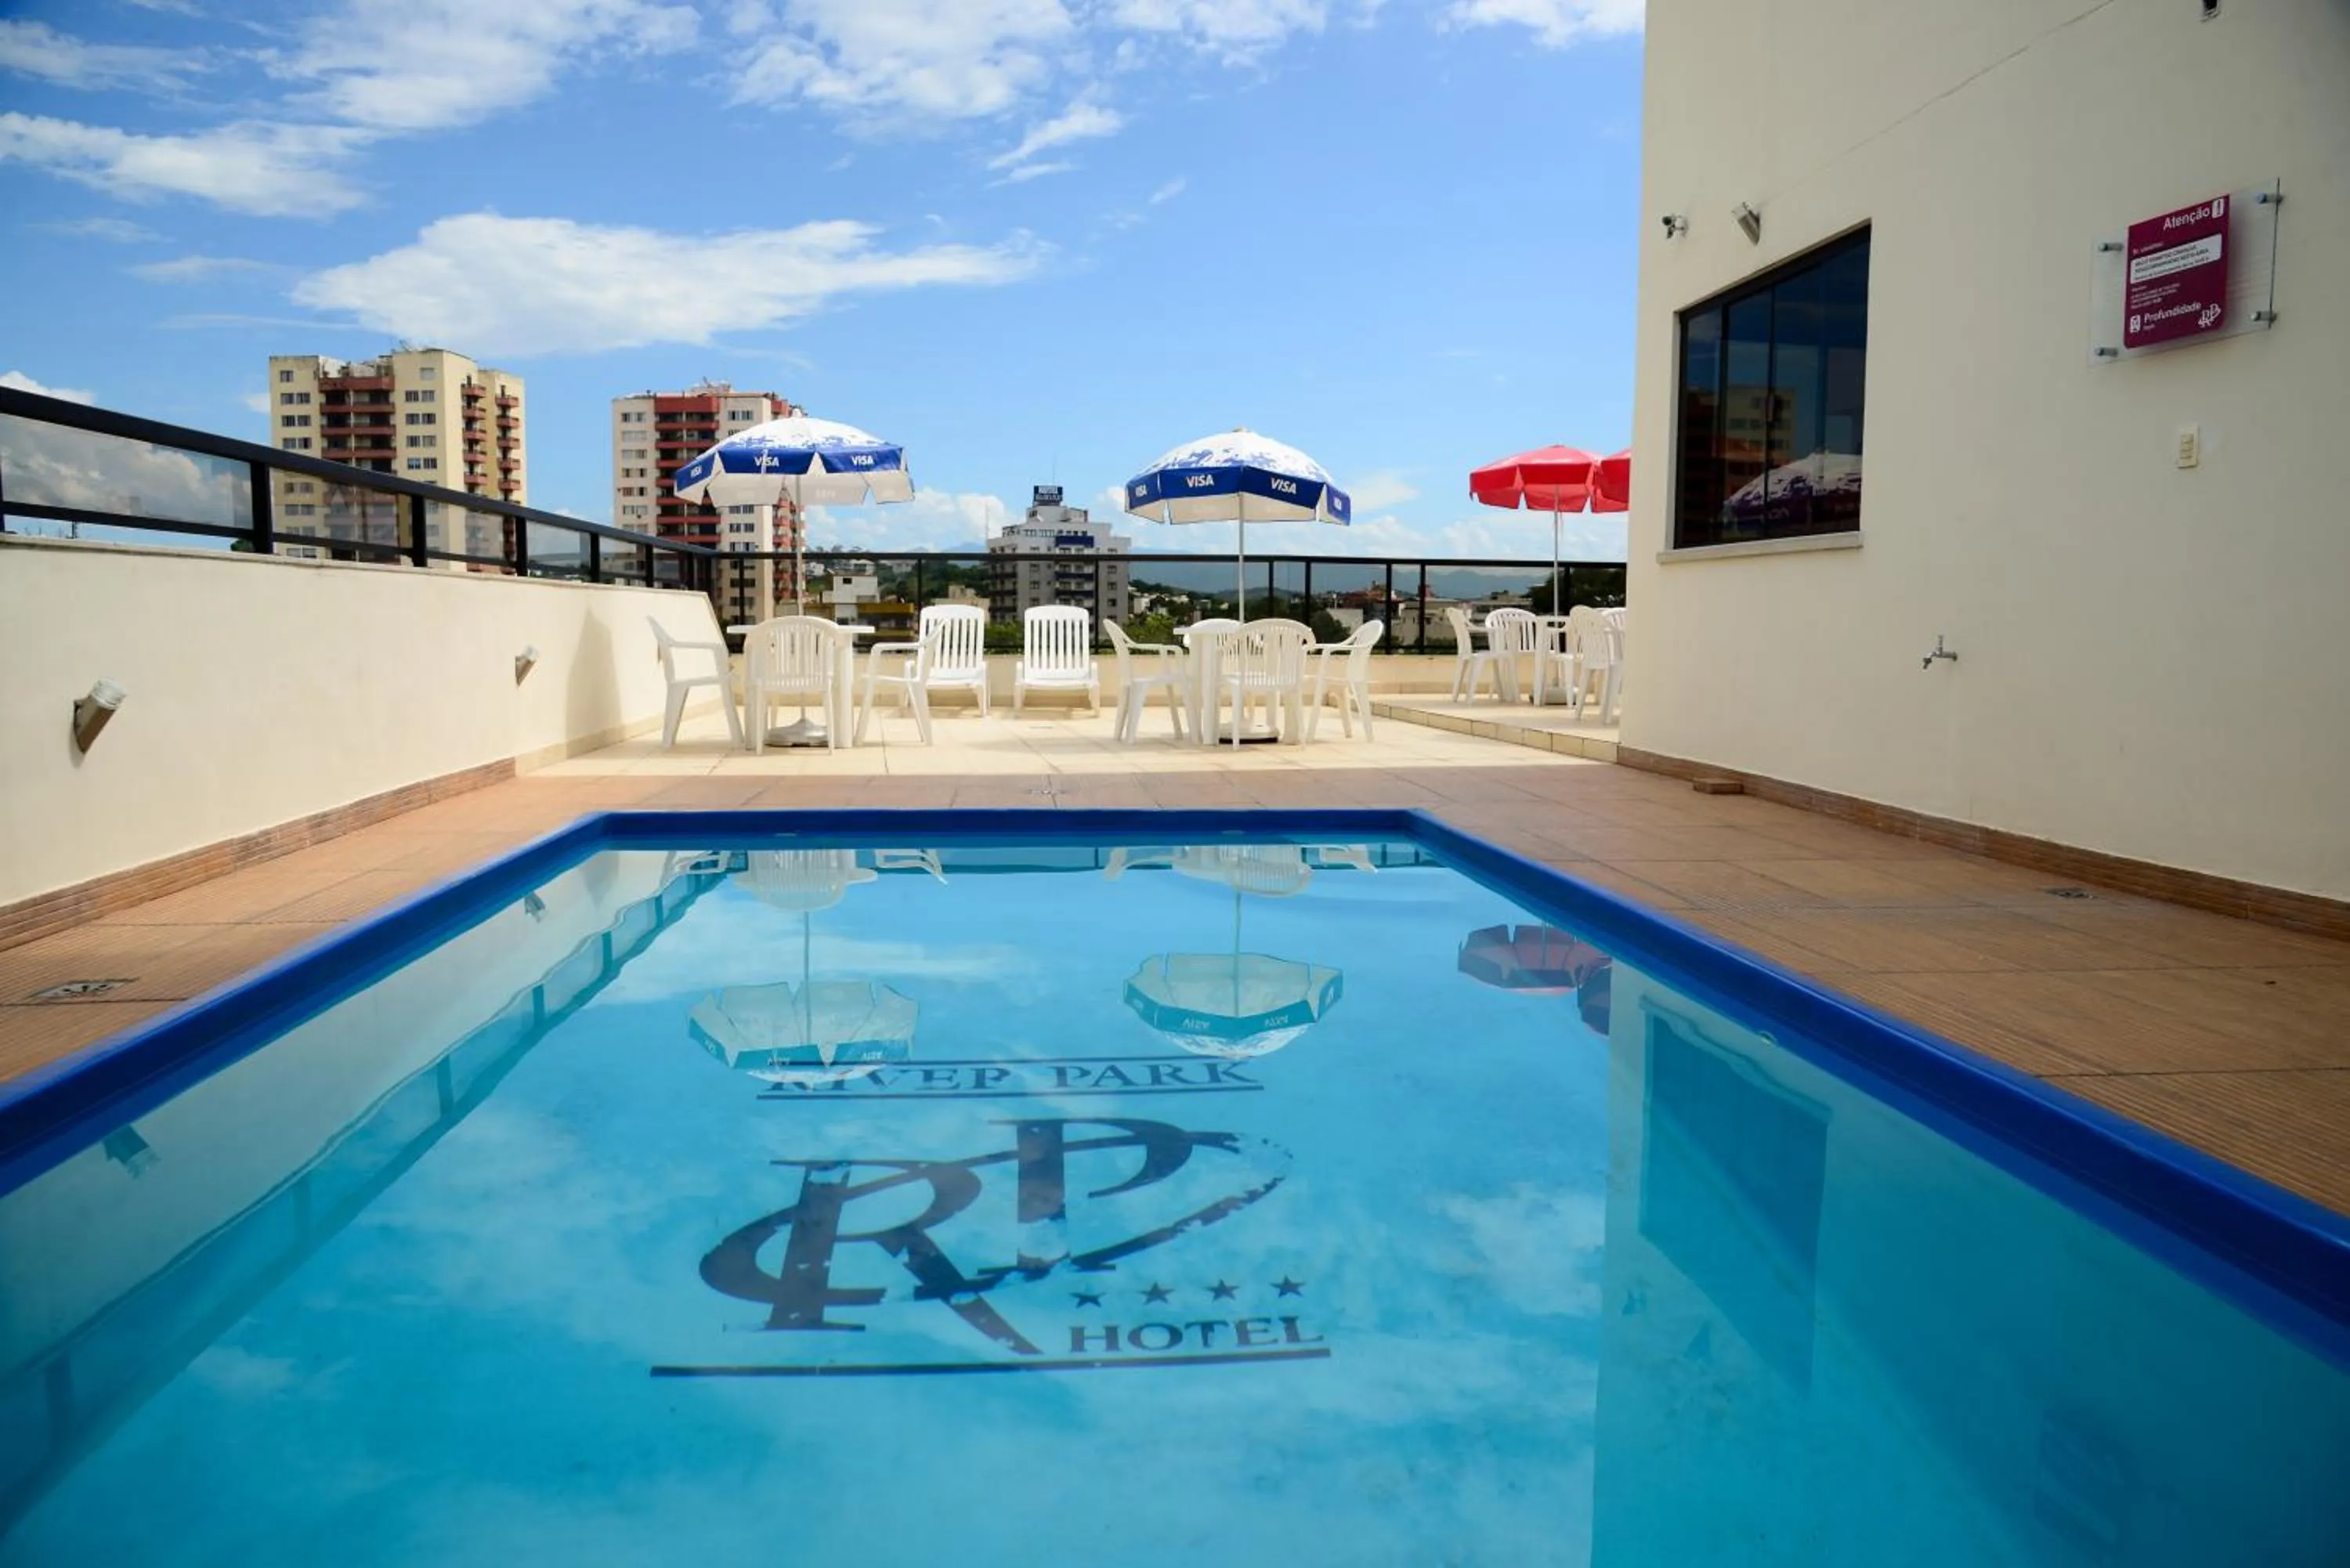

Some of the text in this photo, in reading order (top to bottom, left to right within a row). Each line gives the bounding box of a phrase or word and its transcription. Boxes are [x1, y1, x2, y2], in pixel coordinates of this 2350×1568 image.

[2163, 207, 2210, 230] Atenção
[754, 457, 779, 467] VISA
[851, 455, 874, 465] VISA
[1186, 474, 1214, 488] VISA
[1271, 477, 1297, 494] VISA
[1045, 1060, 1260, 1088] PARK
[1068, 1316, 1325, 1353] HOTEL
